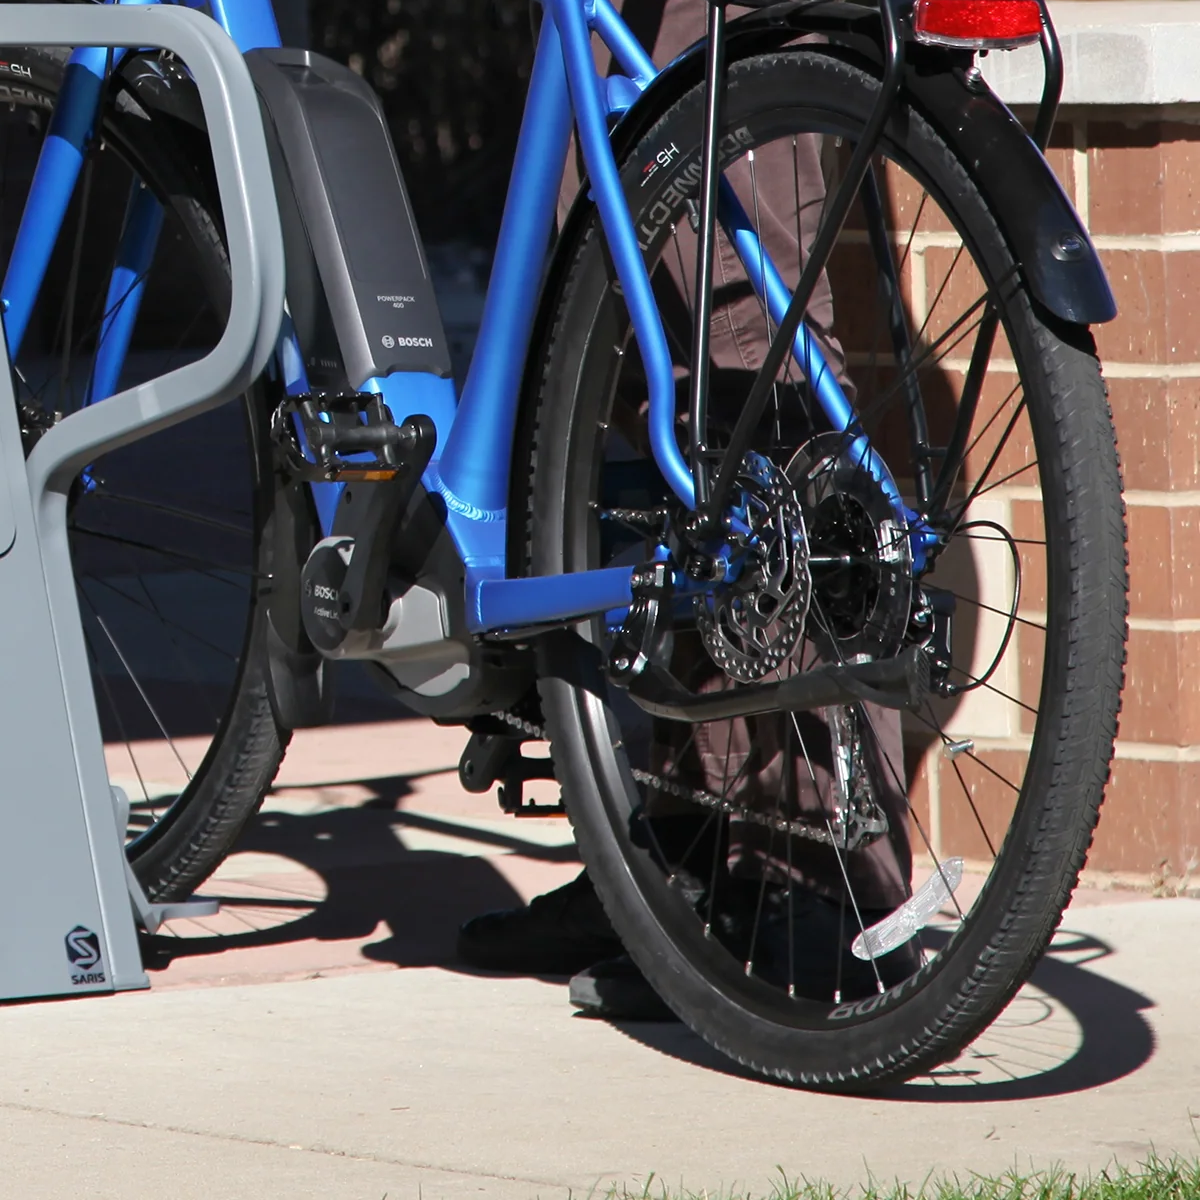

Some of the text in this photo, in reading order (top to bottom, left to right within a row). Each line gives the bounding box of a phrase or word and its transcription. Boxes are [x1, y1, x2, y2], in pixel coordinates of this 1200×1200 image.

[656, 142, 680, 168] H5
[397, 337, 434, 348] BOSCH
[71, 972, 106, 985] SARIS
